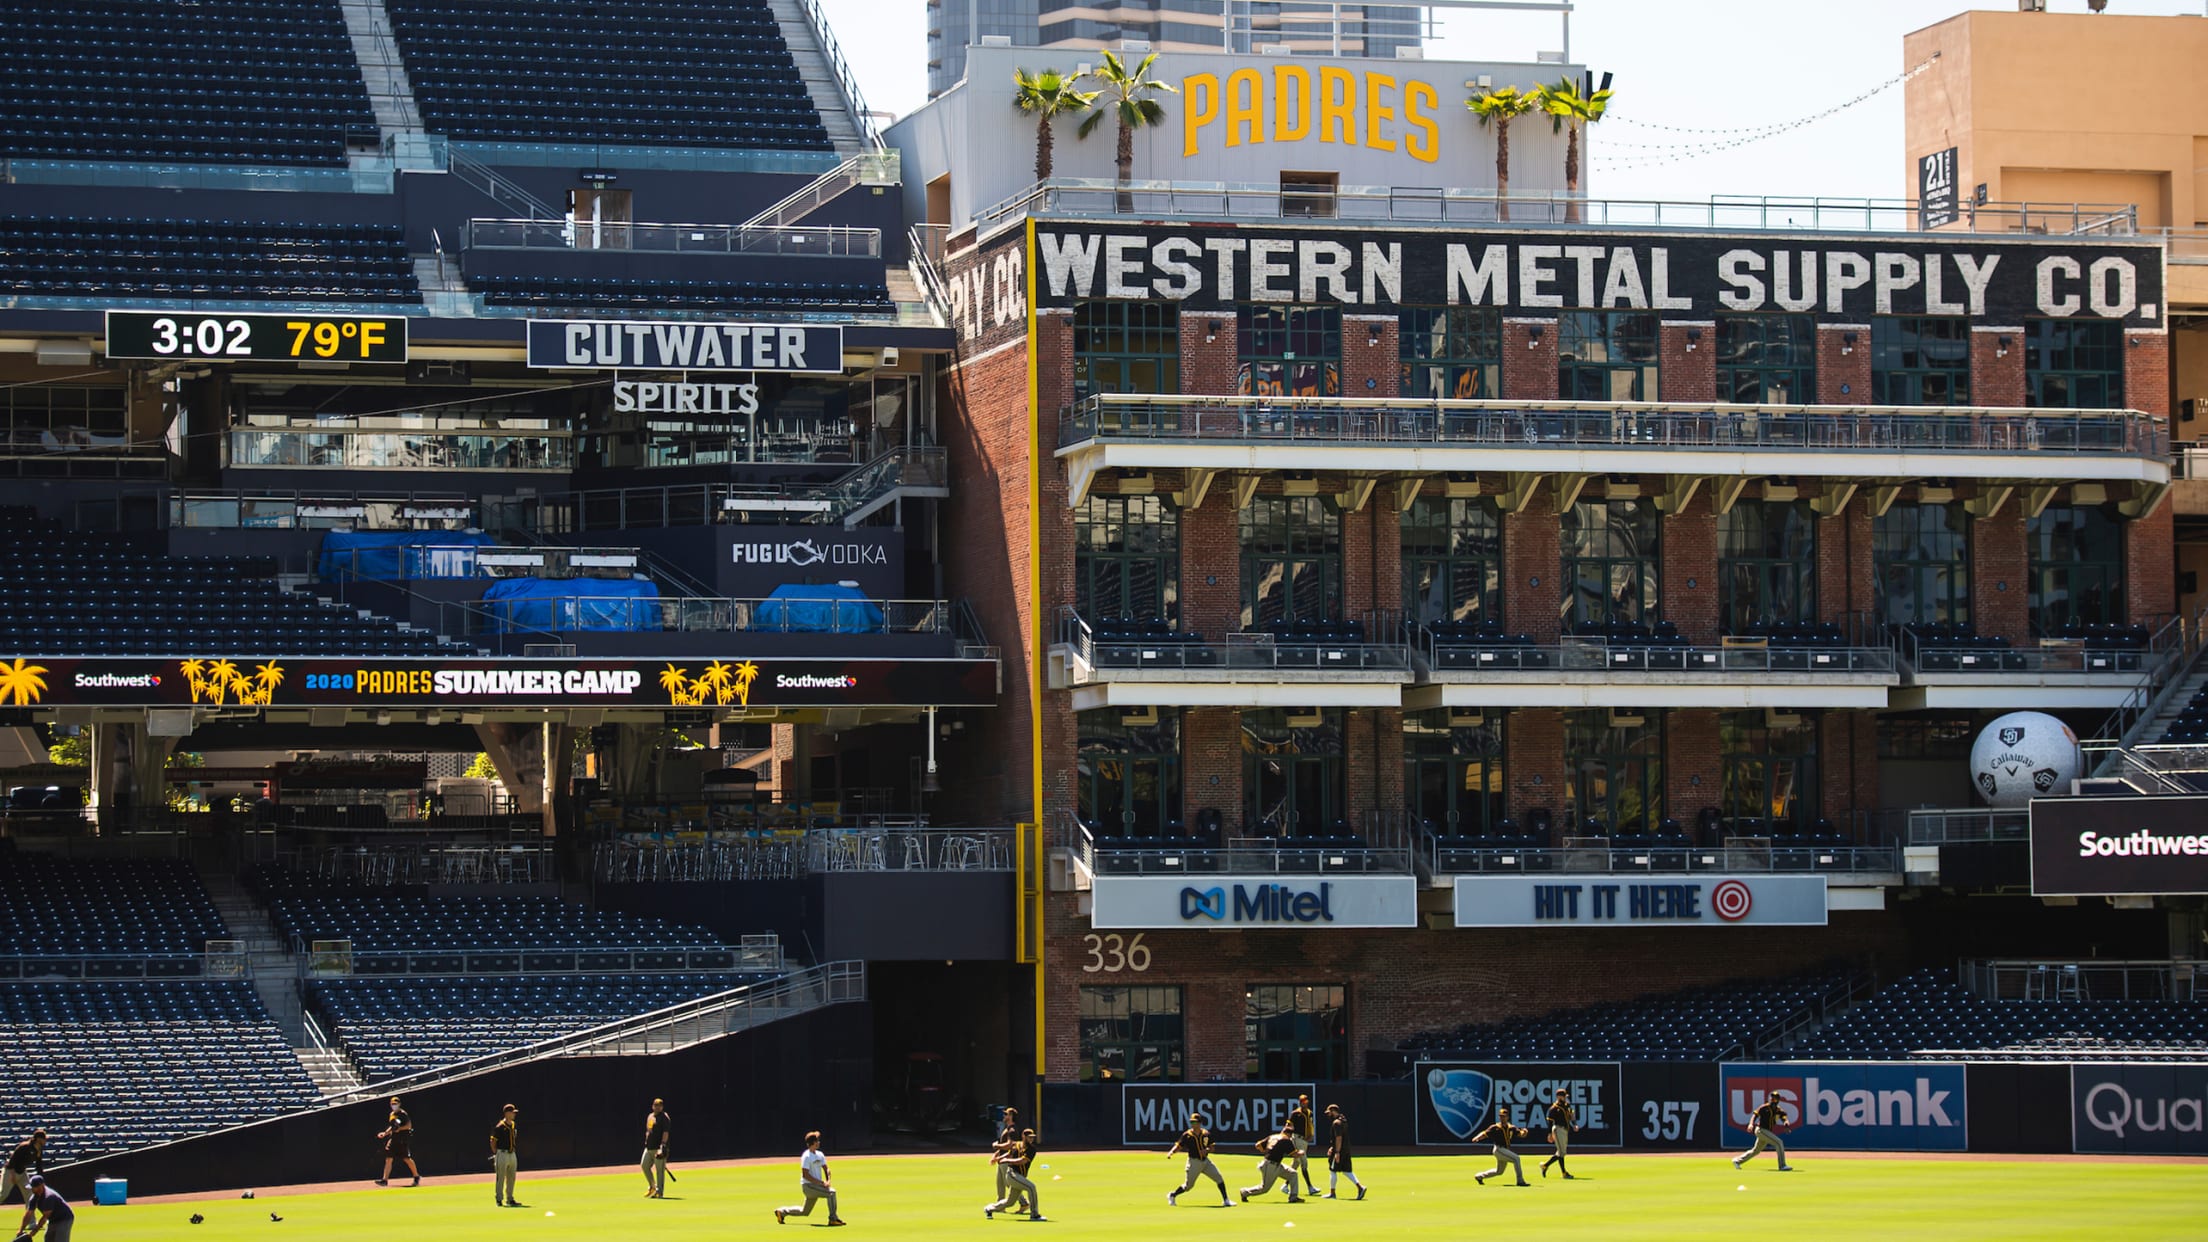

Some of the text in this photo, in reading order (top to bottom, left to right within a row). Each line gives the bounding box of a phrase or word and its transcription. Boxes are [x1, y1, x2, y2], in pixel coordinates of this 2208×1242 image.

[1183, 65, 1439, 163] PADRES
[1925, 152, 1945, 192] 21
[1038, 233, 2157, 319] WESTERN METAL SUPPLY CO.
[152, 318, 386, 358] 3:02 79°F
[565, 323, 807, 369] CUTWATER
[613, 380, 759, 415] SPIRITS
[732, 543, 887, 564] FUGU VODKA
[75, 673, 151, 687] Southwest
[306, 670, 641, 694] 2020 PADRES SUMMER CAMP
[776, 673, 847, 688] Southwest
[1990, 752, 2035, 769] Callaway
[1233, 882, 1334, 922] Mitel
[1534, 885, 1702, 920] HIT IT HERE
[1082, 933, 1151, 973] 336
[1494, 1079, 1603, 1104] ROCKET
[2085, 1082, 2208, 1138] Qua
[1495, 1104, 1604, 1130] LEAUE
[1642, 1100, 1700, 1141] 357
